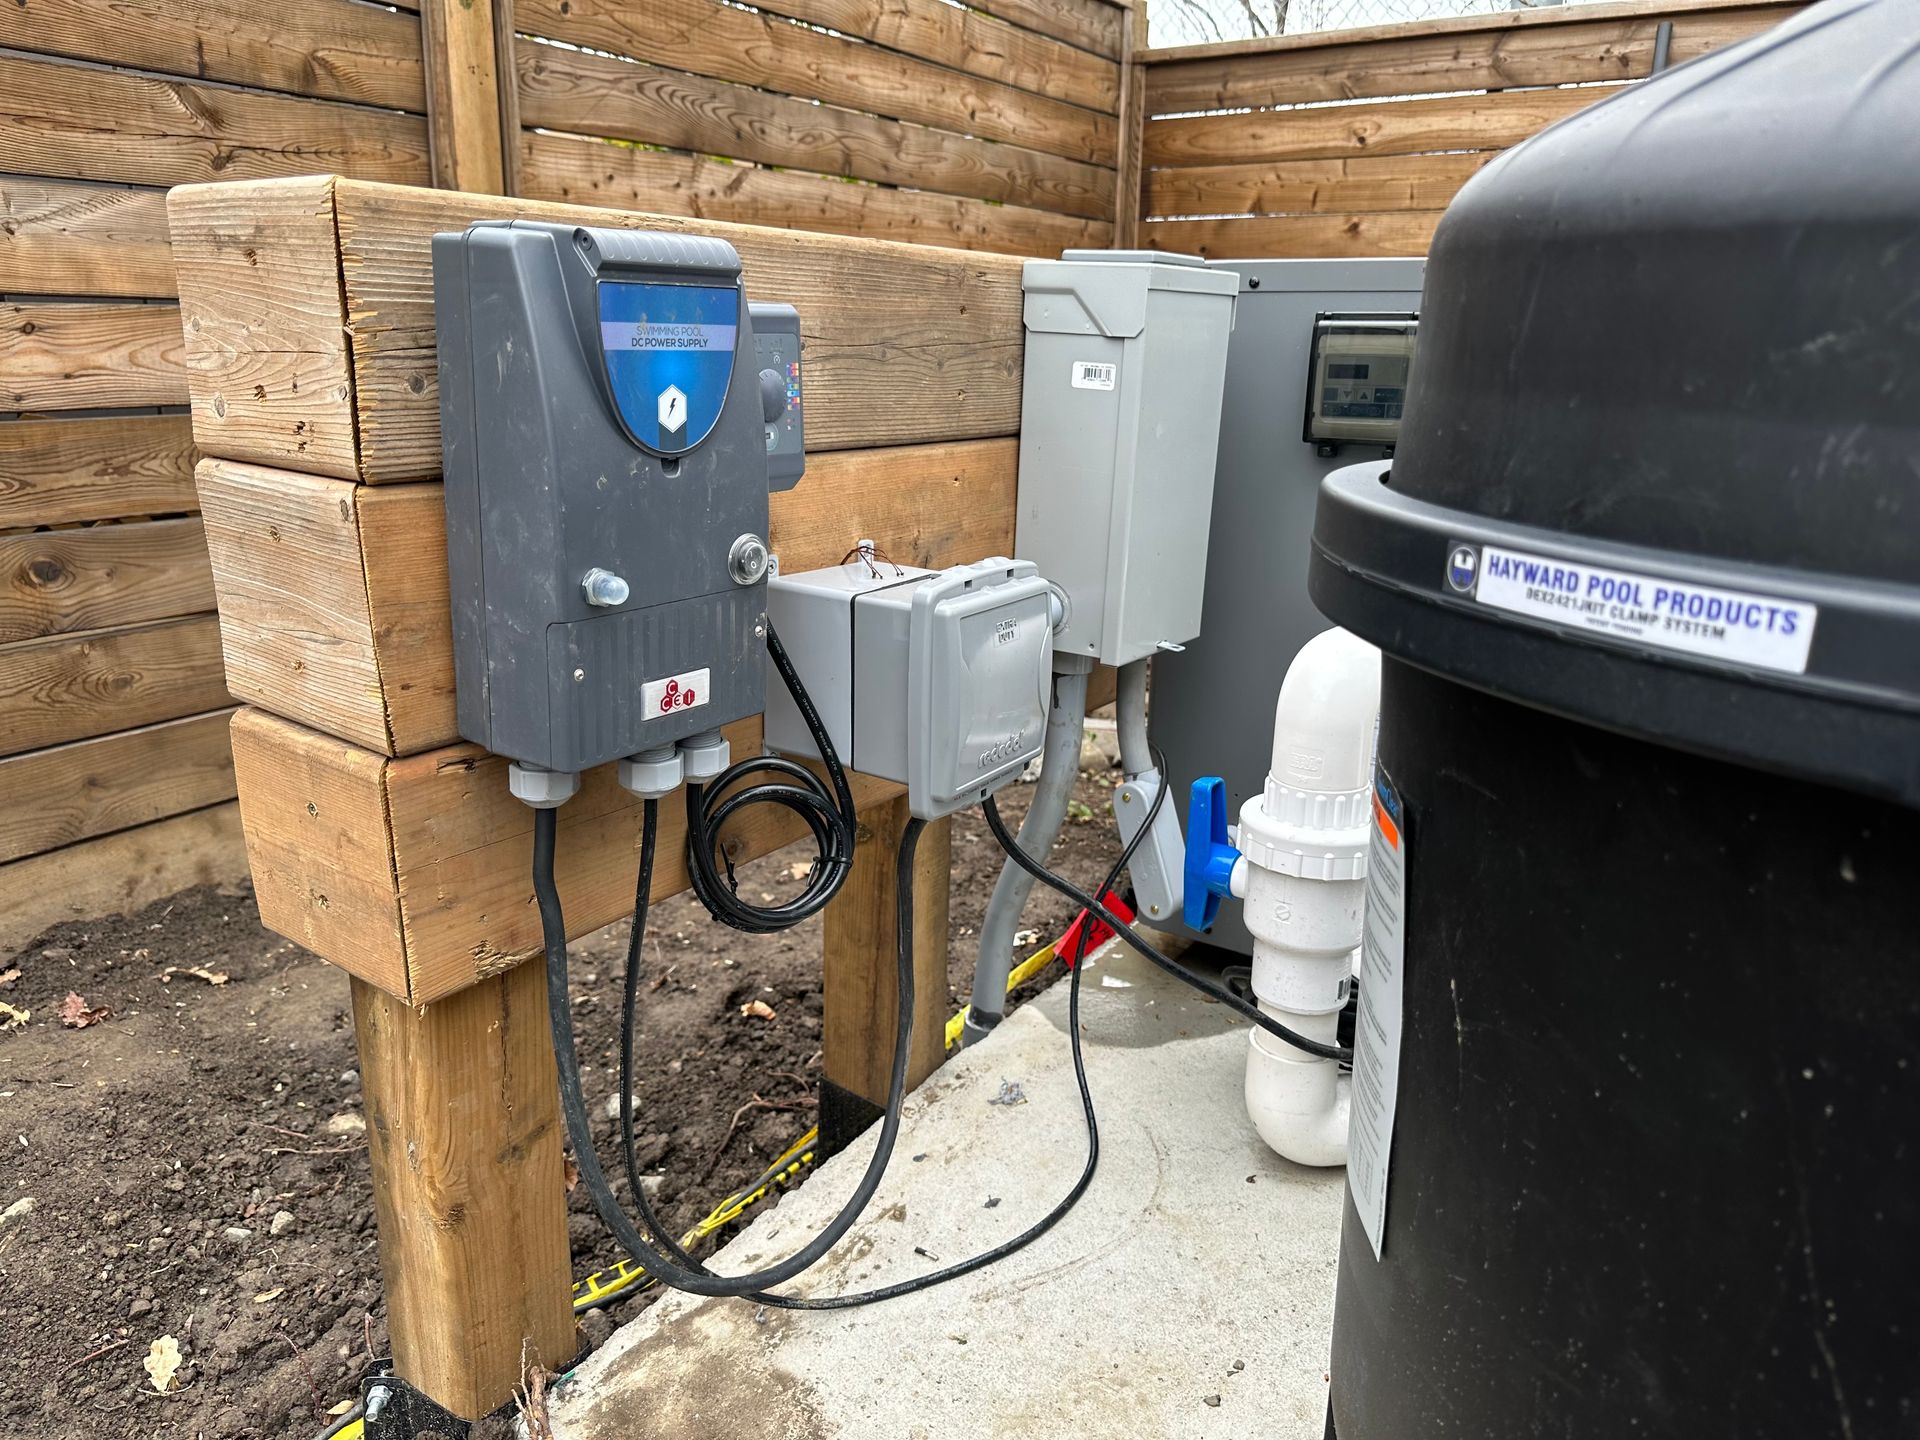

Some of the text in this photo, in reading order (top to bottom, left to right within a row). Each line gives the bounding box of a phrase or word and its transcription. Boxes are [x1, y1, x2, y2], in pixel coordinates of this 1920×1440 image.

[631, 337, 709, 348] DC POWER SUPPLY
[636, 326, 704, 337] SWIMMING POOL
[1488, 554, 1580, 593] HAYWARD
[1586, 574, 1643, 605] POOL
[1654, 587, 1799, 636] PRODUCTS
[1609, 606, 1659, 626] CLAMP
[1664, 616, 1727, 641] SYSTEM
